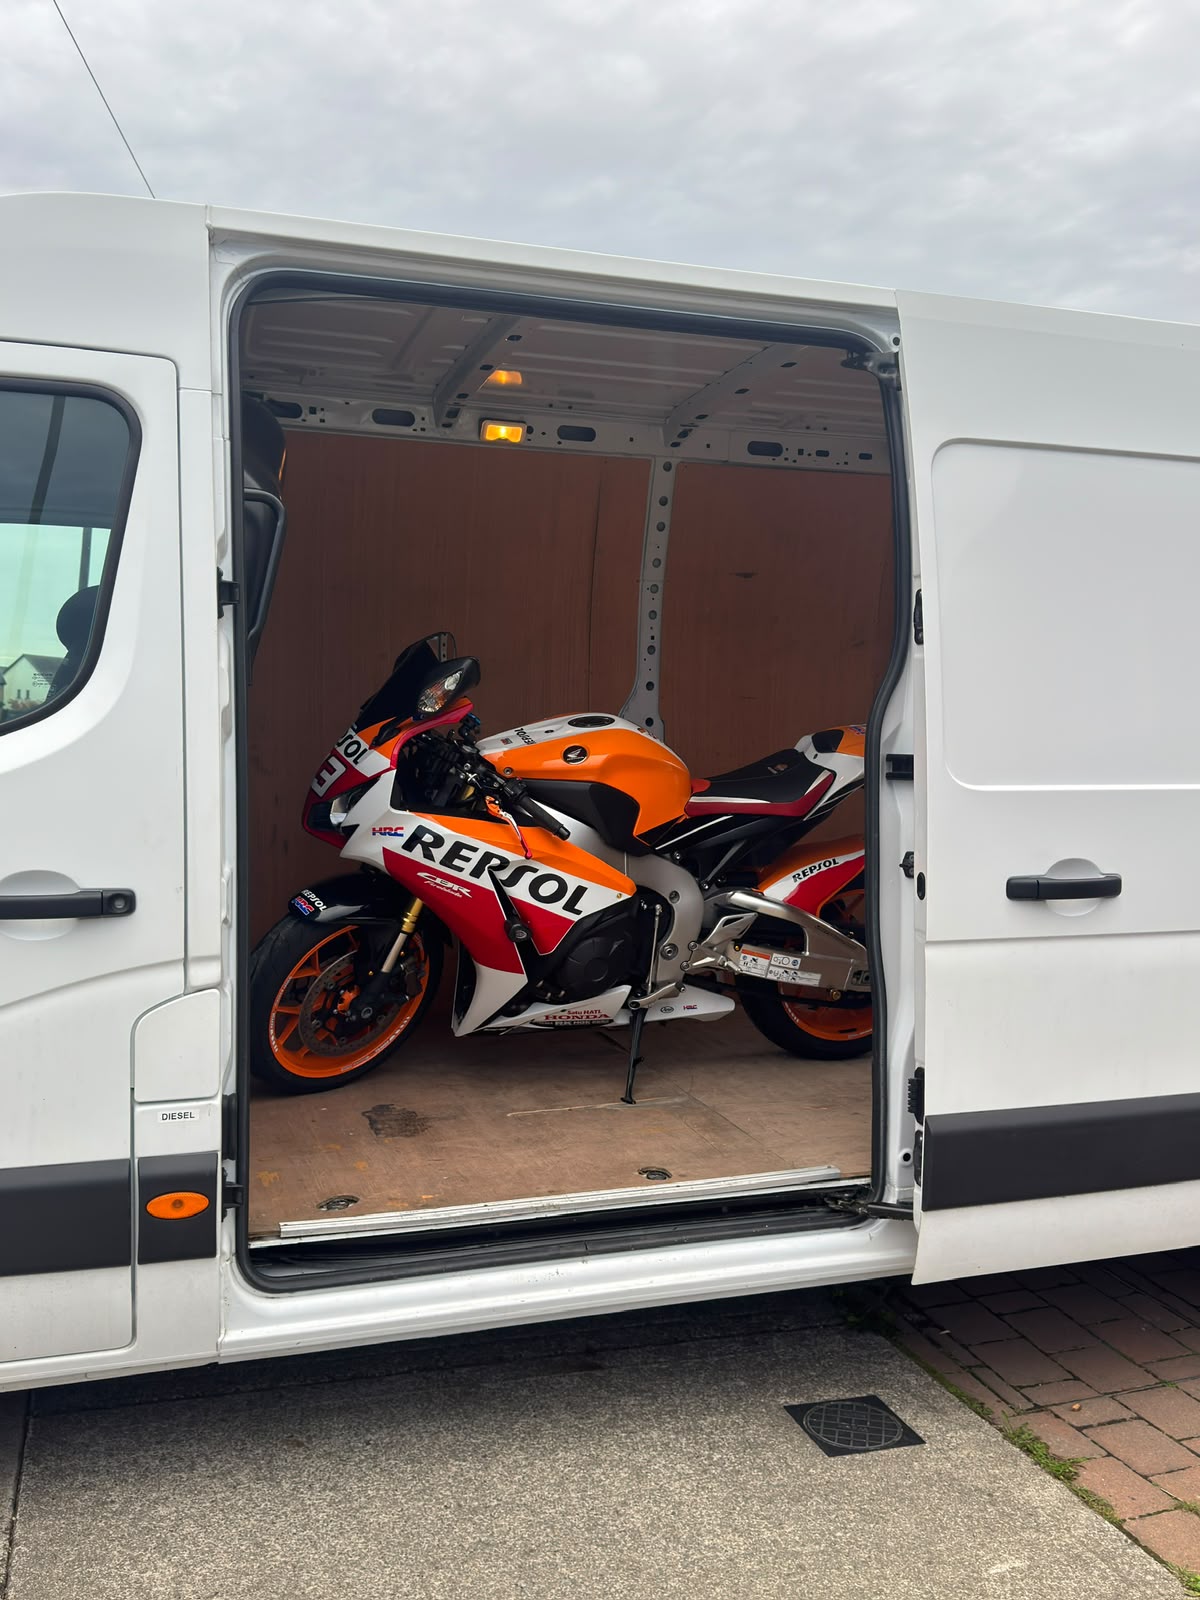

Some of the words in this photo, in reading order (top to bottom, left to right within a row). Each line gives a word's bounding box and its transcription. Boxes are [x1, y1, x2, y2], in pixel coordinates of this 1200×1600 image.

[371, 826, 404, 838] HRC
[401, 824, 589, 916] REPSOL
[792, 858, 839, 883] REPSOL
[416, 872, 473, 899] CBR
[301, 889, 328, 912] REPSOL
[544, 1013, 611, 1021] HONDA
[161, 1111, 195, 1121] DIESEL
